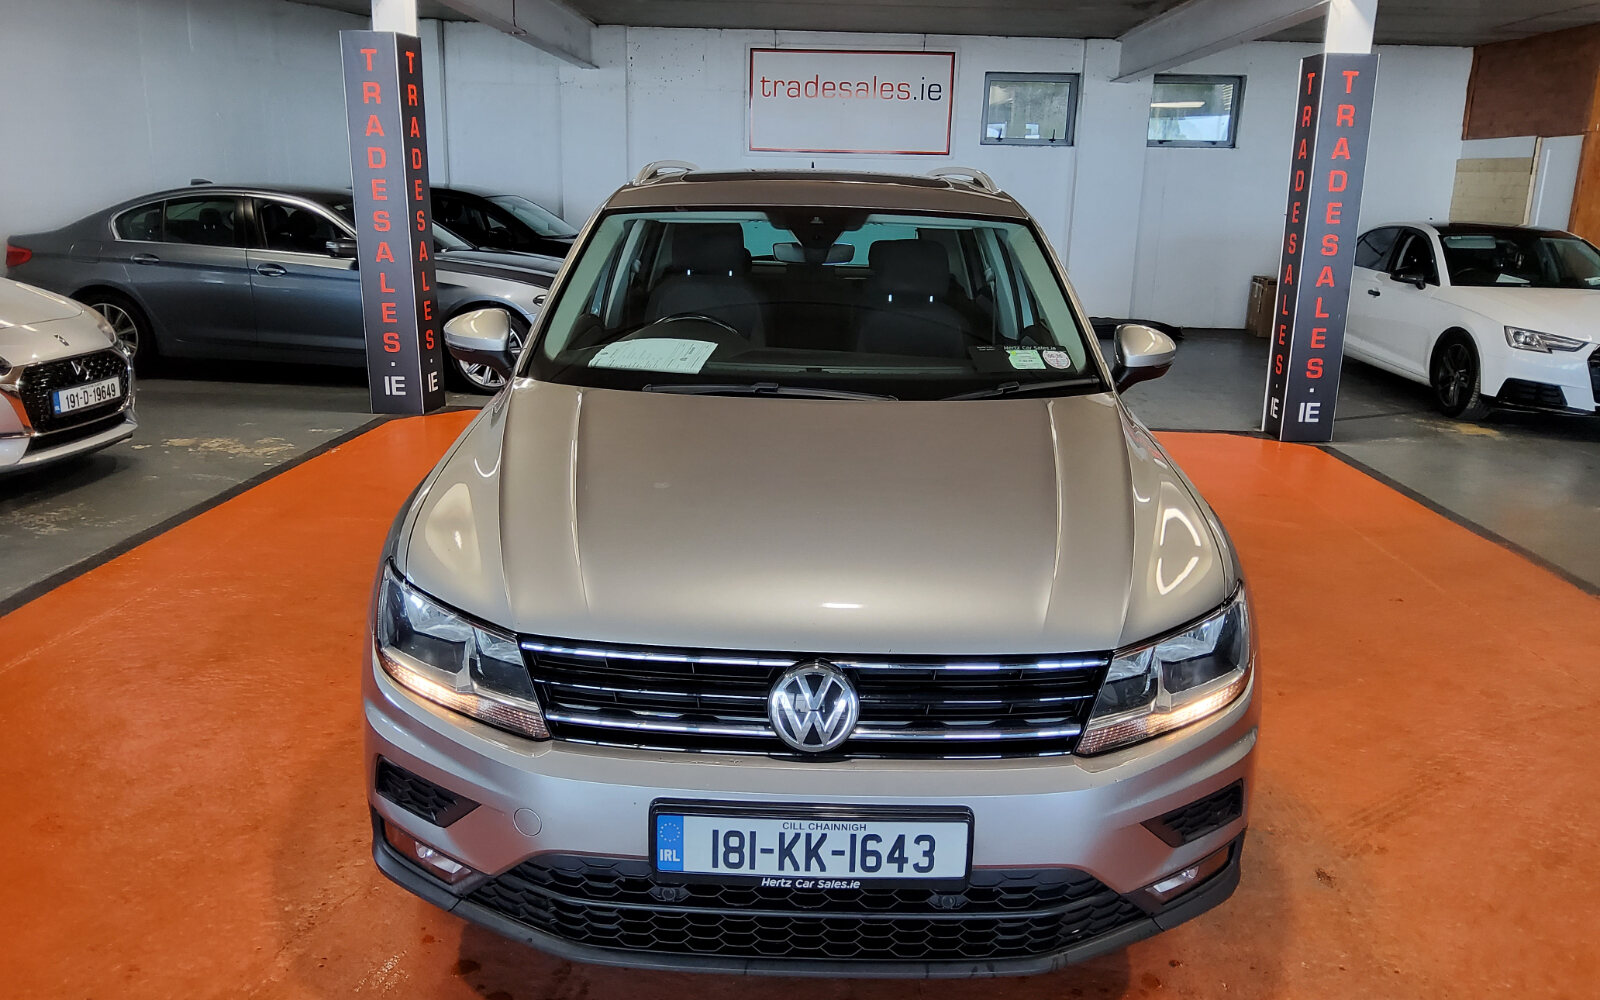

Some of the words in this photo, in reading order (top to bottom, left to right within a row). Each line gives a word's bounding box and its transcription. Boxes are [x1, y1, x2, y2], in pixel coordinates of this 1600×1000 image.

[760, 73, 942, 101] tradesales.ie
[65, 383, 116, 409] 191-D-19649
[782, 821, 806, 831] CILL
[808, 822, 867, 832] CHAINNIGH
[659, 848, 681, 862] IRL
[711, 829, 936, 873] 181-KK-1643
[761, 877, 792, 888] Hertz
[795, 879, 814, 888] Car
[817, 879, 861, 889] Sales.ie
